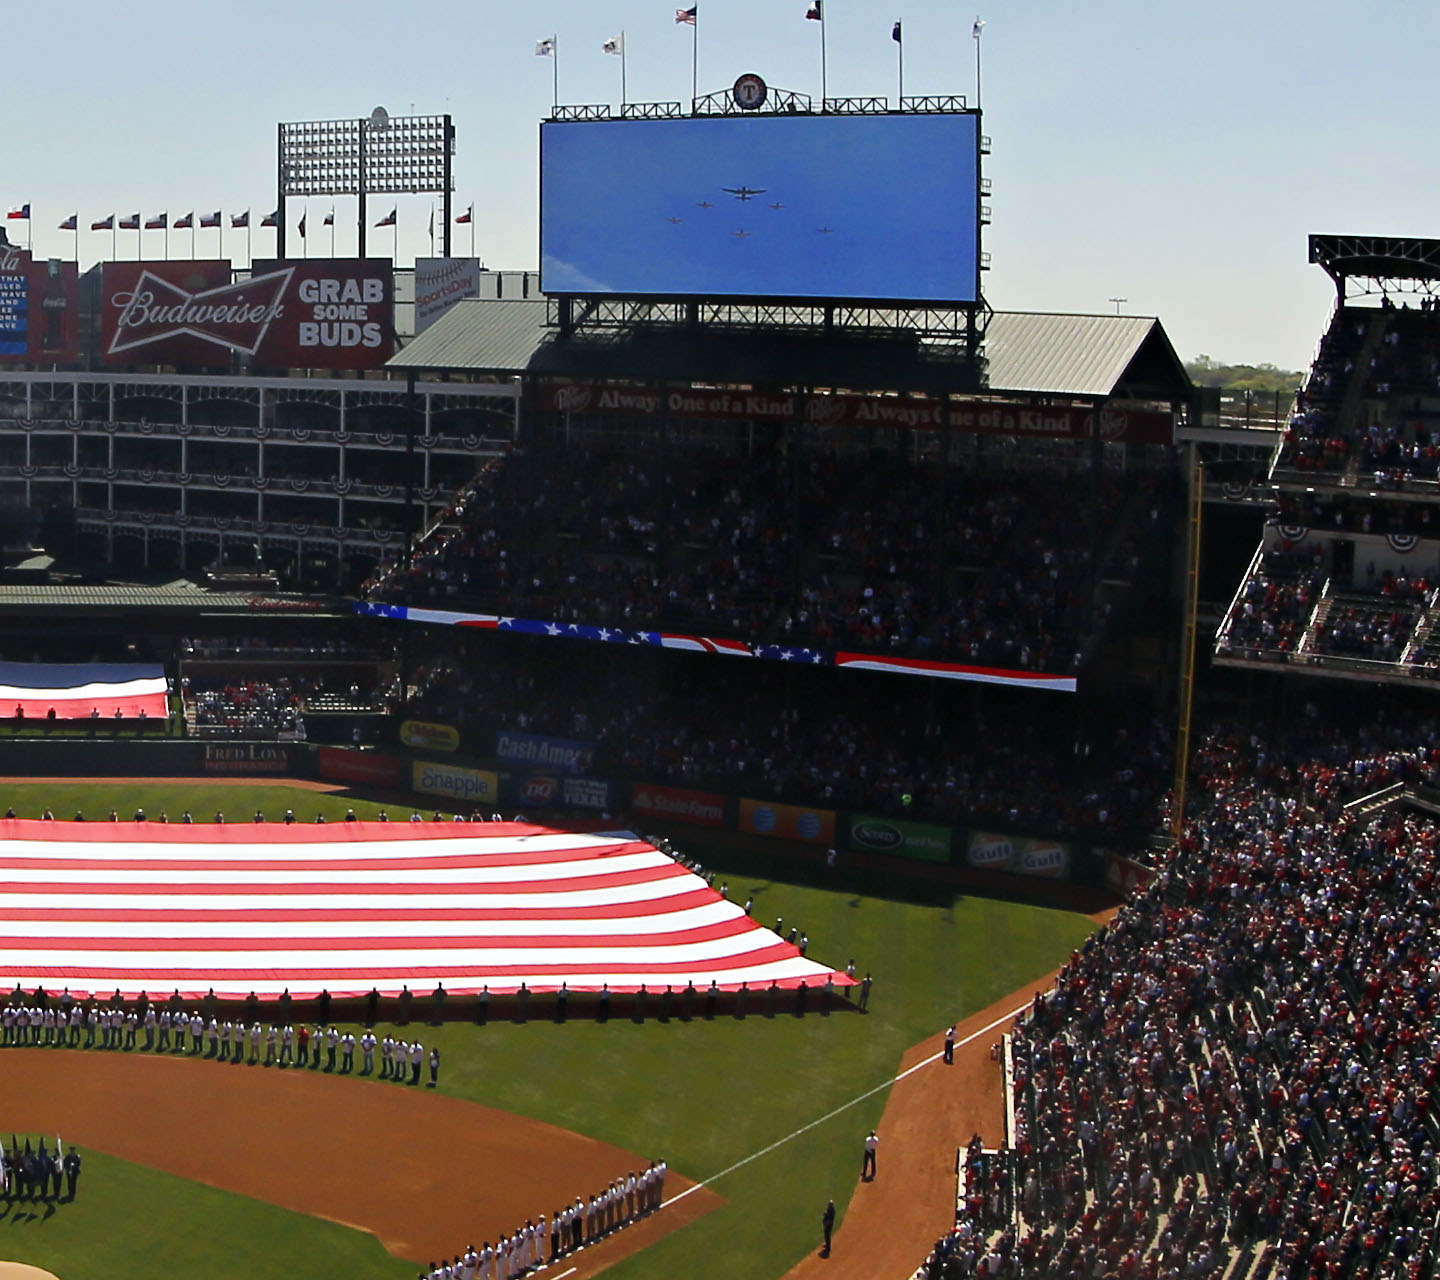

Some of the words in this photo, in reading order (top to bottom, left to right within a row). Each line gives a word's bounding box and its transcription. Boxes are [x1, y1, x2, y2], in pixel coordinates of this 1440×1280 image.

[298, 278, 384, 304] GRAB
[111, 291, 283, 327] Budweiser
[313, 304, 368, 320] SOME
[299, 322, 382, 347] BUDS
[669, 393, 706, 411] One
[709, 395, 732, 412] of
[732, 400, 744, 412] a
[745, 397, 795, 416] Kind
[855, 401, 932, 425] Always
[978, 410, 1003, 428] of
[1003, 416, 1015, 428] a
[1020, 411, 1072, 431] Kind
[497, 736, 537, 760] Cash
[423, 768, 488, 798] Snapple
[527, 783, 552, 797] DQ
[564, 791, 608, 808] TEXAS
[973, 842, 1011, 861] Gulf
[1024, 851, 1062, 868] Gulf
